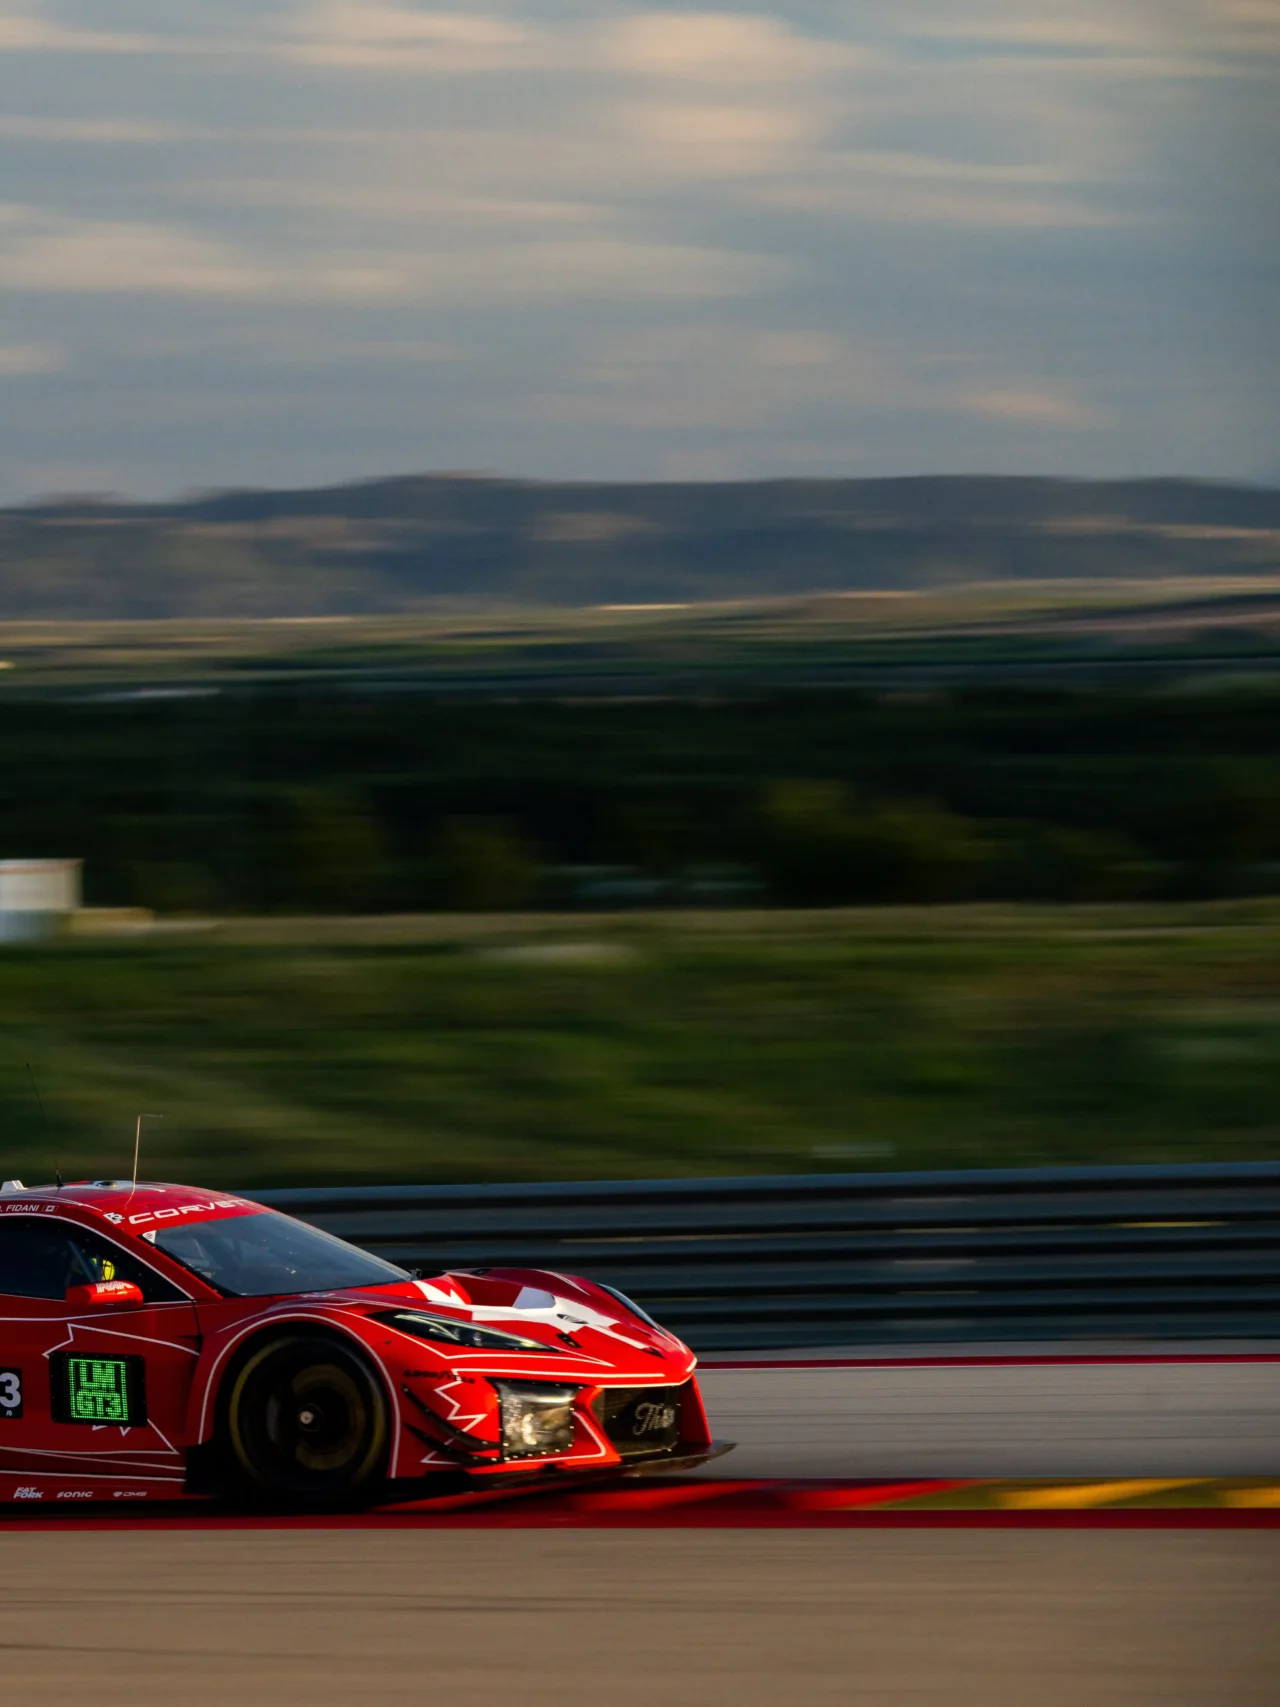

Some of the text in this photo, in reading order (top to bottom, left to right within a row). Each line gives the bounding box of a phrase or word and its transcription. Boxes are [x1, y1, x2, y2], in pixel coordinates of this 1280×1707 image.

[5, 1203, 40, 1213] FIDANI
[128, 1199, 248, 1225] CORVET
[79, 1362, 116, 1389] LM
[76, 1391, 122, 1417] GT3
